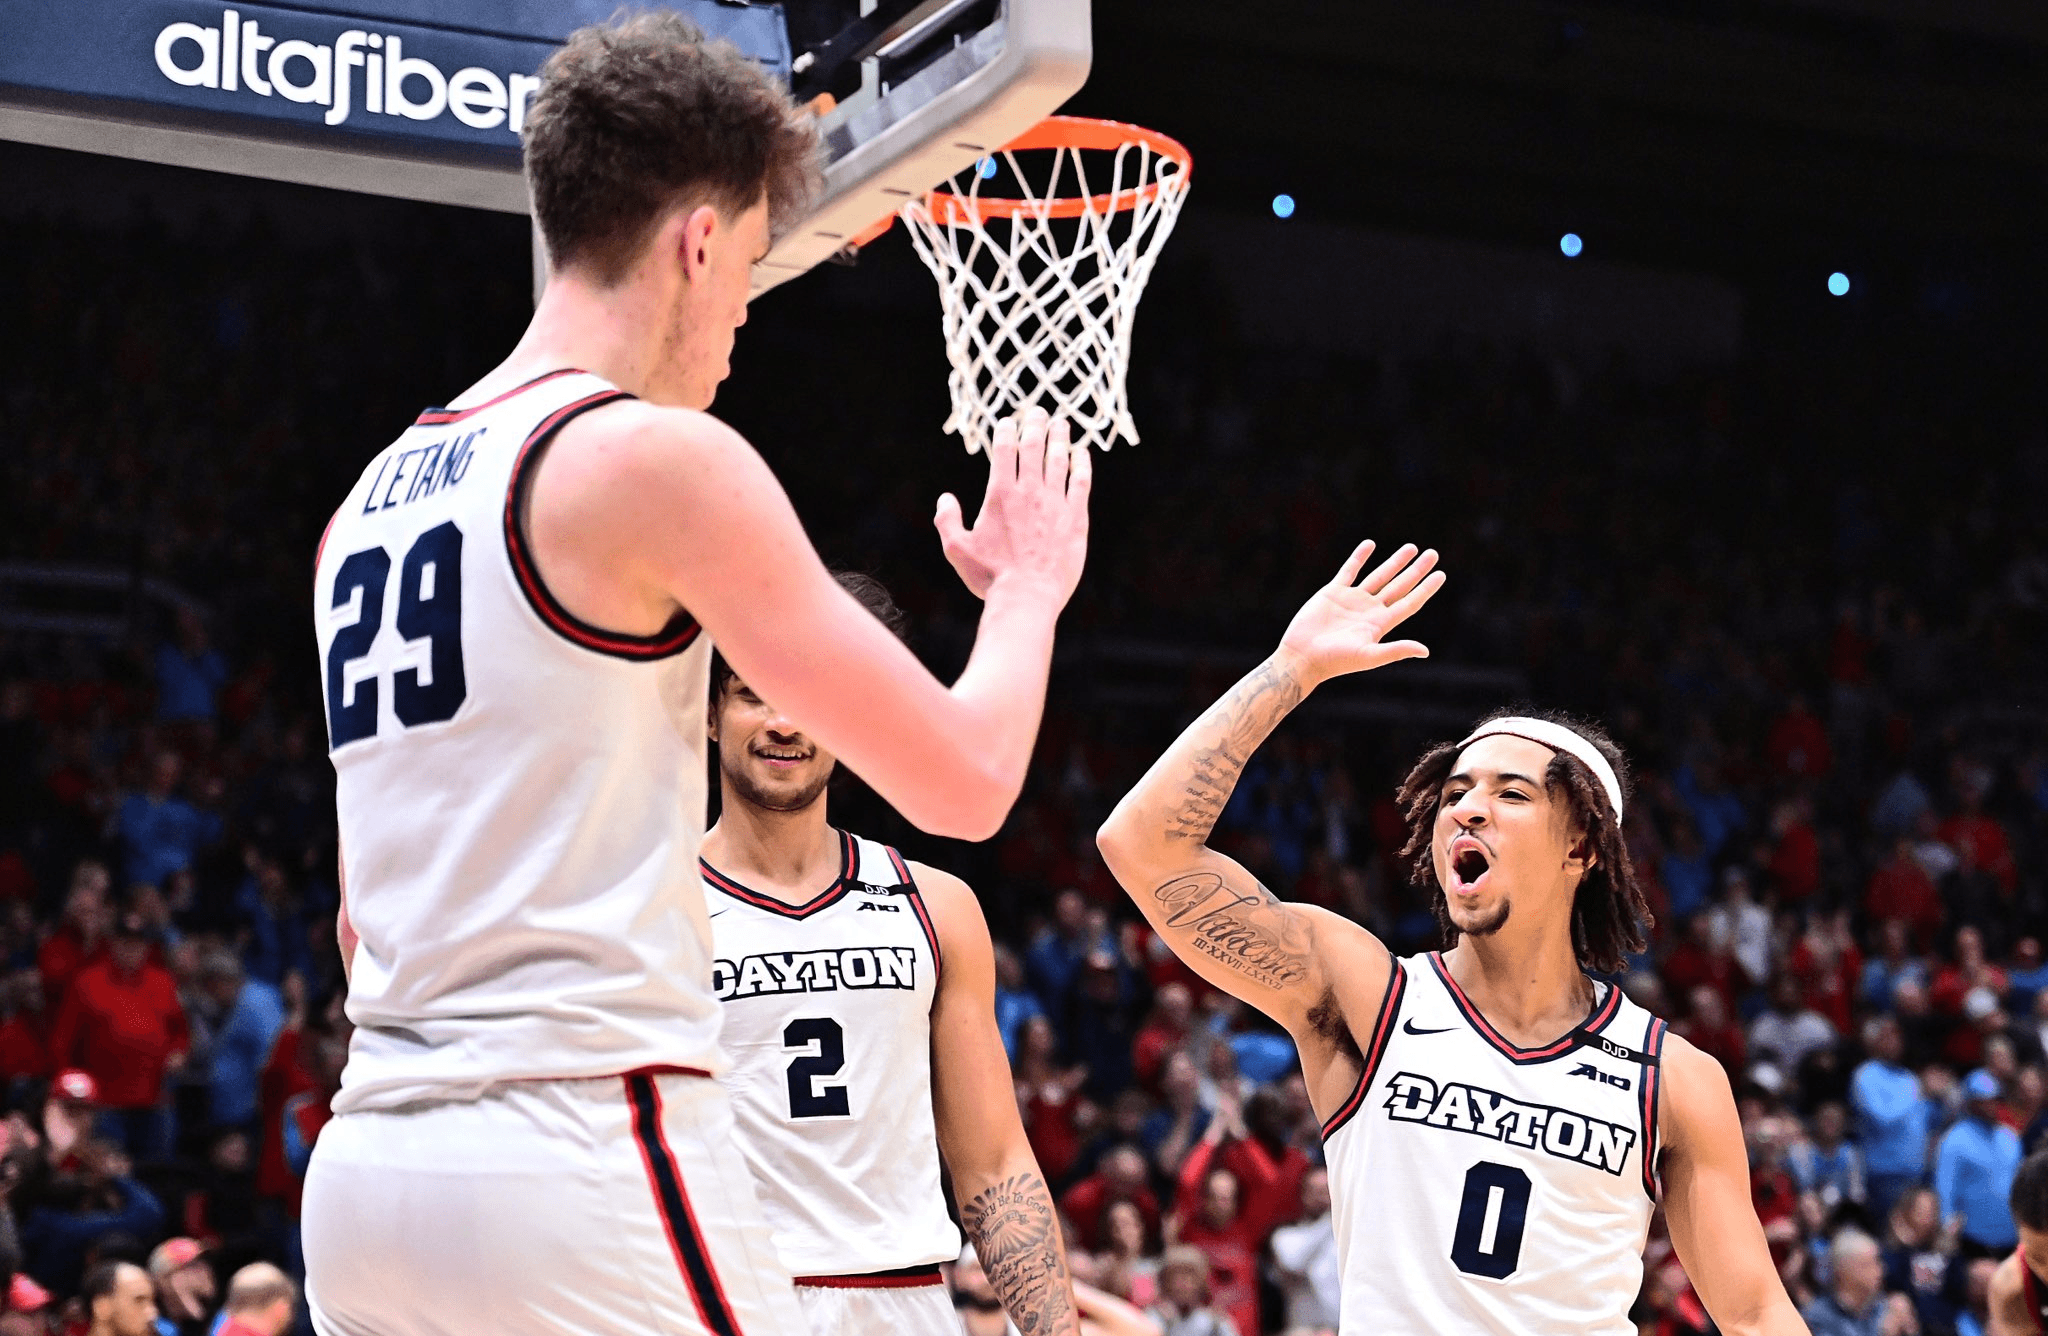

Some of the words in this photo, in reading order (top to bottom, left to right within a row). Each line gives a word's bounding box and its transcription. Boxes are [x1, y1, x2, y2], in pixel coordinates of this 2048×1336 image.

[154, 9, 541, 134] altafiber
[328, 520, 467, 750] 29
[864, 884, 890, 896] DJD
[1155, 872, 1307, 984] Vanessa
[783, 1017, 851, 1119] 2
[1566, 1062, 1631, 1091] A10
[1602, 1039, 1630, 1059] DJD
[1382, 1071, 1637, 1177] DAYTON
[1026, 1196, 1047, 1215] God
[1450, 1160, 1532, 1280] 0
